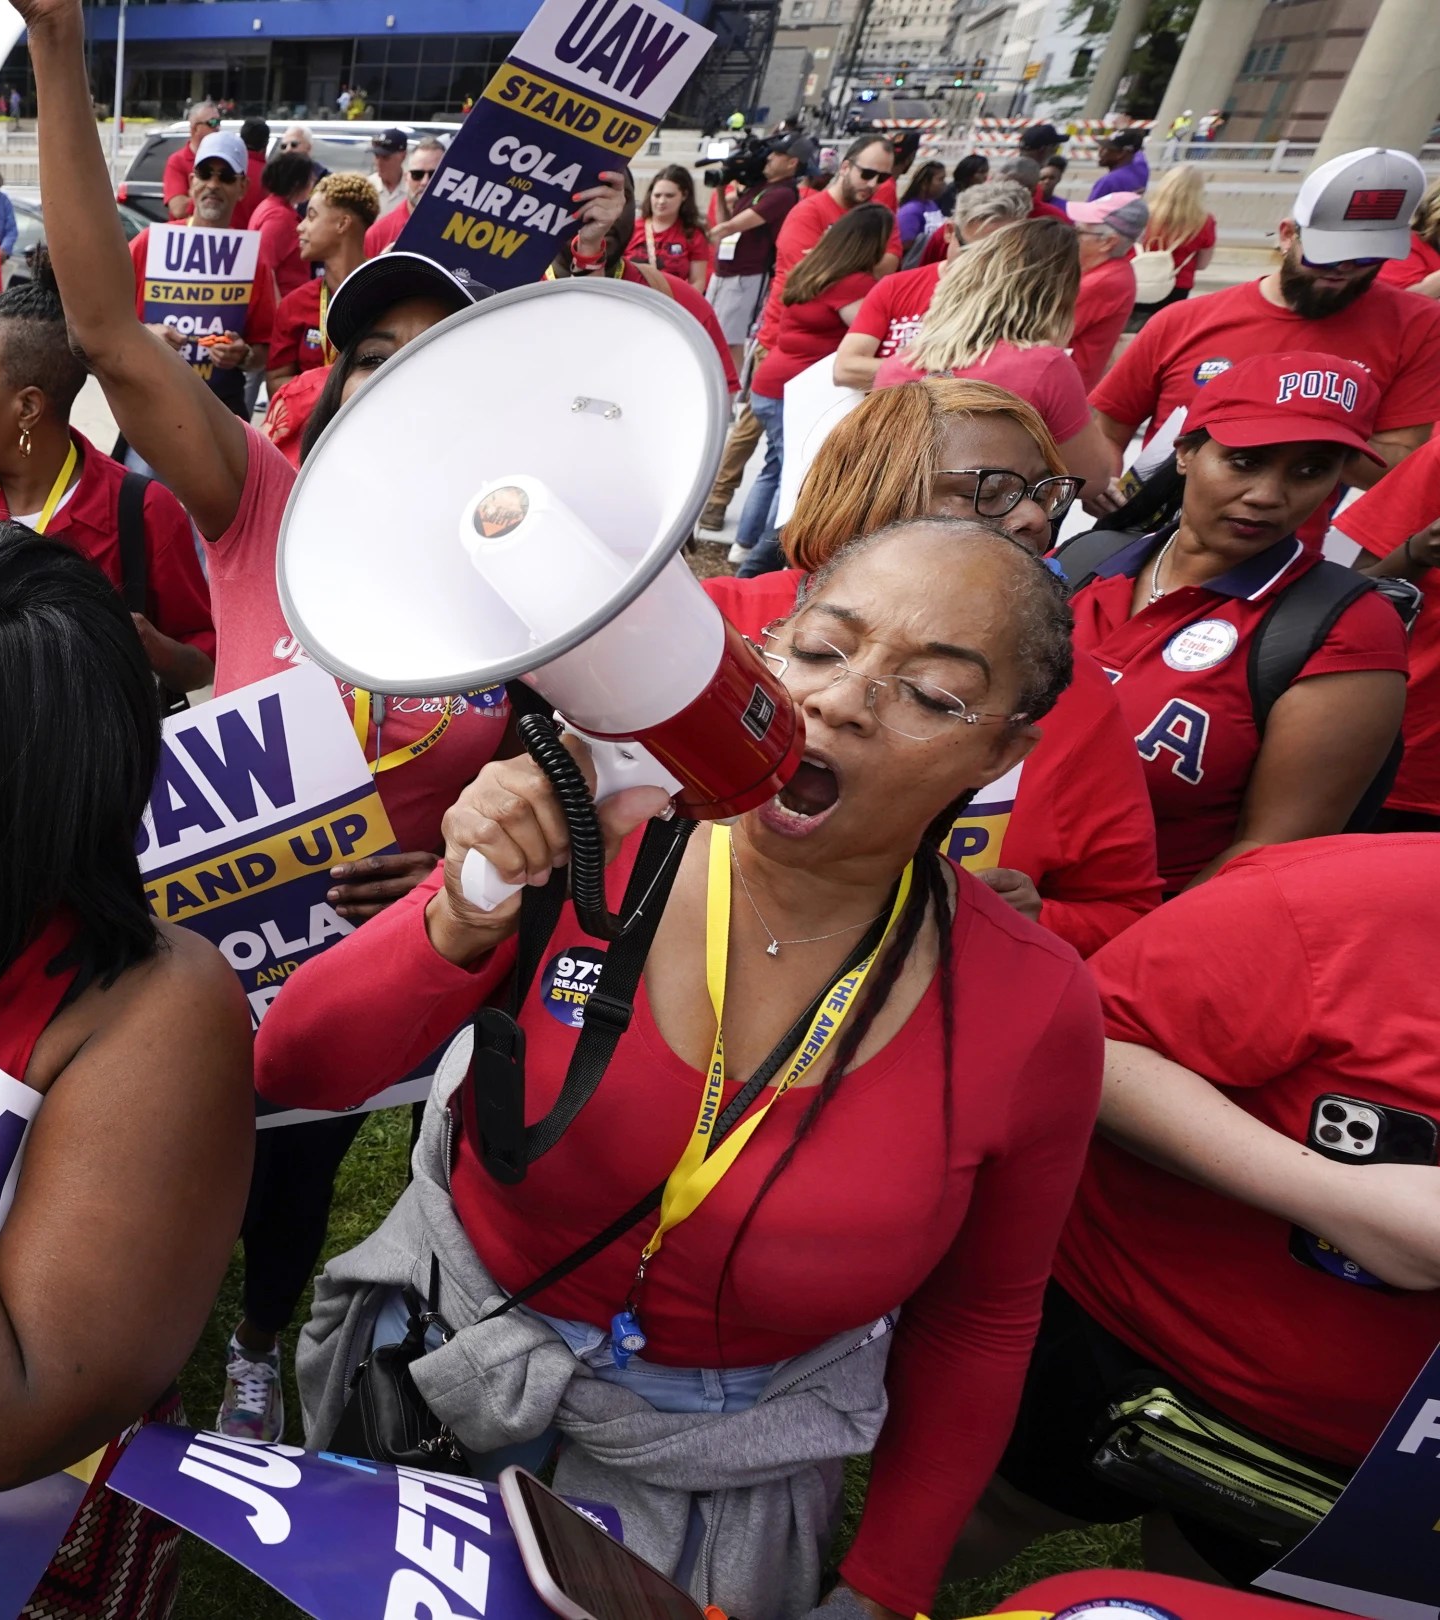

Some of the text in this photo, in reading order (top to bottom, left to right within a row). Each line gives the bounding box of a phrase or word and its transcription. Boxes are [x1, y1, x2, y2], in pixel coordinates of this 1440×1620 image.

[555, 0, 690, 100] UAW
[498, 75, 642, 148] STAND UP
[489, 136, 583, 192] COLA
[506, 176, 532, 191] AND
[432, 167, 577, 236] FAIR PAY
[165, 232, 243, 275] UAW
[441, 212, 529, 259] NOW
[151, 285, 245, 301] STAND UP
[163, 315, 224, 335] COLA
[1276, 371, 1358, 413] POLO
[410, 719, 449, 756] DREAM
[136, 693, 296, 855] AW
[288, 813, 368, 867] UP
[219, 902, 358, 971] OLA
[550, 988, 590, 1005] STR
[553, 978, 597, 994] READY
[827, 976, 860, 1014] THE
[776, 1014, 835, 1098] AMERICA
[698, 1062, 723, 1135] UNITED
[1122, 1601, 1145, 1612] Plant
